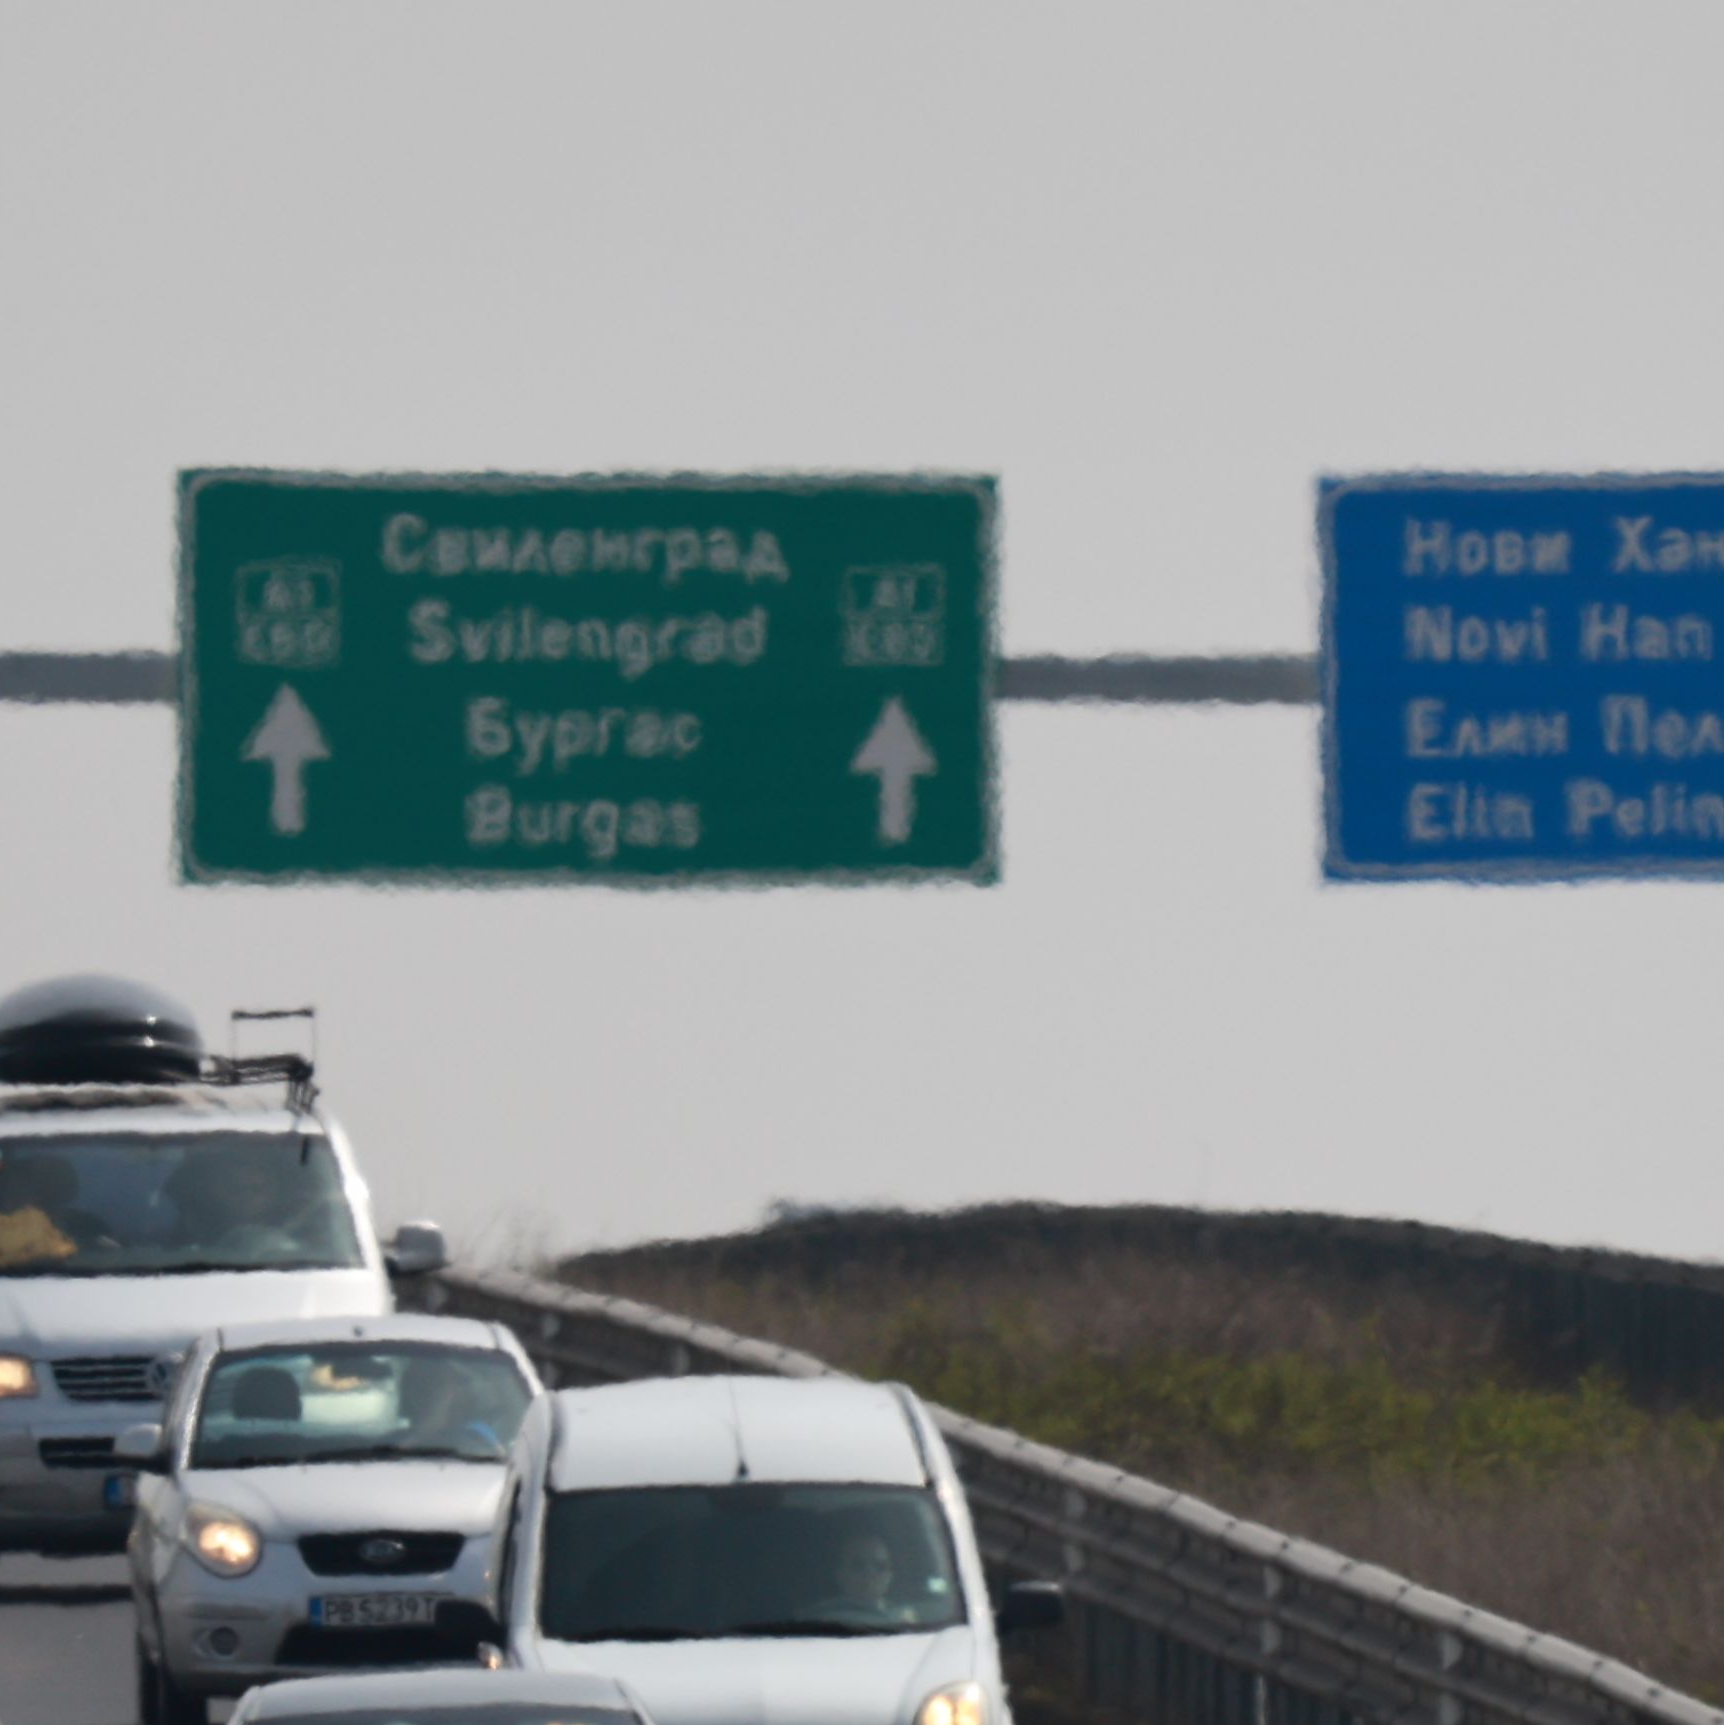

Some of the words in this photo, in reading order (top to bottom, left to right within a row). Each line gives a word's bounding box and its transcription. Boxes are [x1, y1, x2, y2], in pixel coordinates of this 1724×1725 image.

[381, 514, 789, 581] Свиленград
[1404, 518, 1570, 575] Нови
[409, 601, 767, 679] Svilengrad
[1405, 606, 1548, 661] Novi
[1582, 604, 1713, 661] Han
[467, 697, 703, 776] Бургас
[1407, 699, 1567, 757] Елин
[466, 785, 698, 858] Burgas
[1408, 783, 1533, 840] Elin
